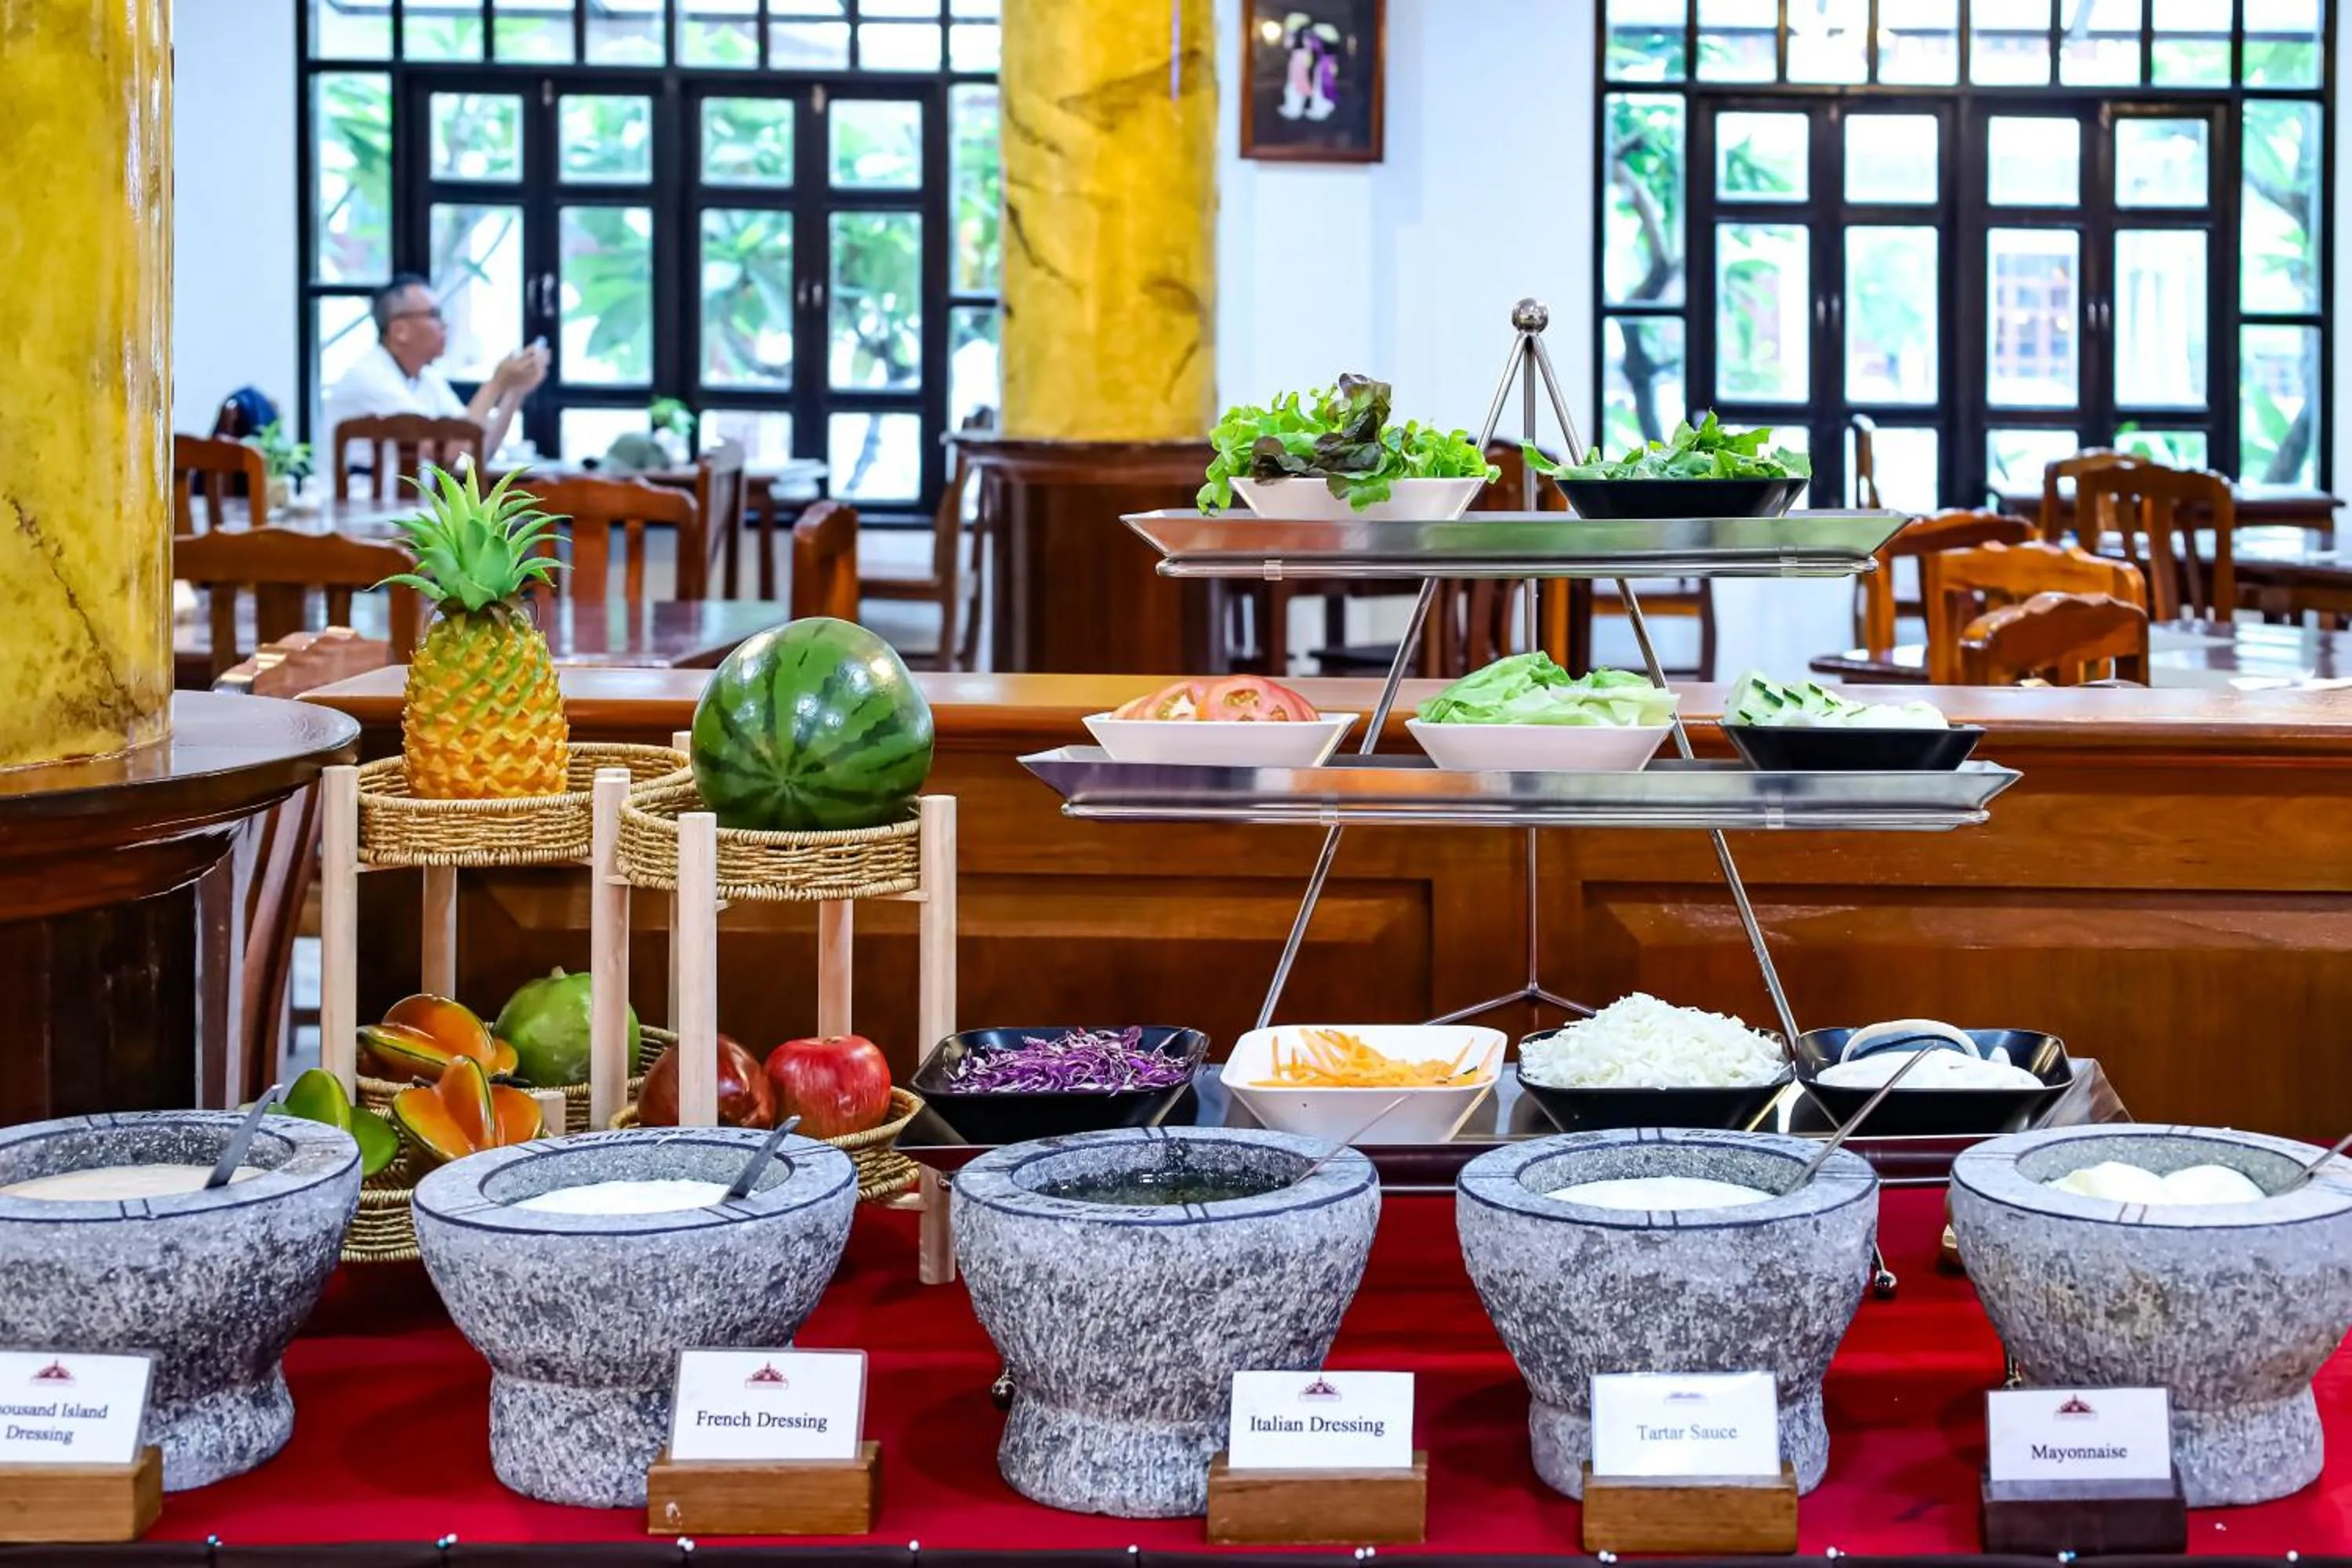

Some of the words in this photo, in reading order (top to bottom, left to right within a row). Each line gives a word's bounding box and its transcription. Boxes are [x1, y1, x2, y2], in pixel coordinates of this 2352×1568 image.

[0, 1402, 58, 1418] ousand
[61, 1403, 108, 1420] Island
[696, 1410, 751, 1428] French
[757, 1412, 828, 1432] Dressing
[1250, 1416, 1303, 1432] Italian
[1310, 1417, 1385, 1436] Dressing
[5, 1425, 74, 1446] Dressing
[1636, 1424, 1685, 1442] Tartar
[1690, 1424, 1738, 1441] Sauce
[2031, 1444, 2126, 1463] Mayonnaise
